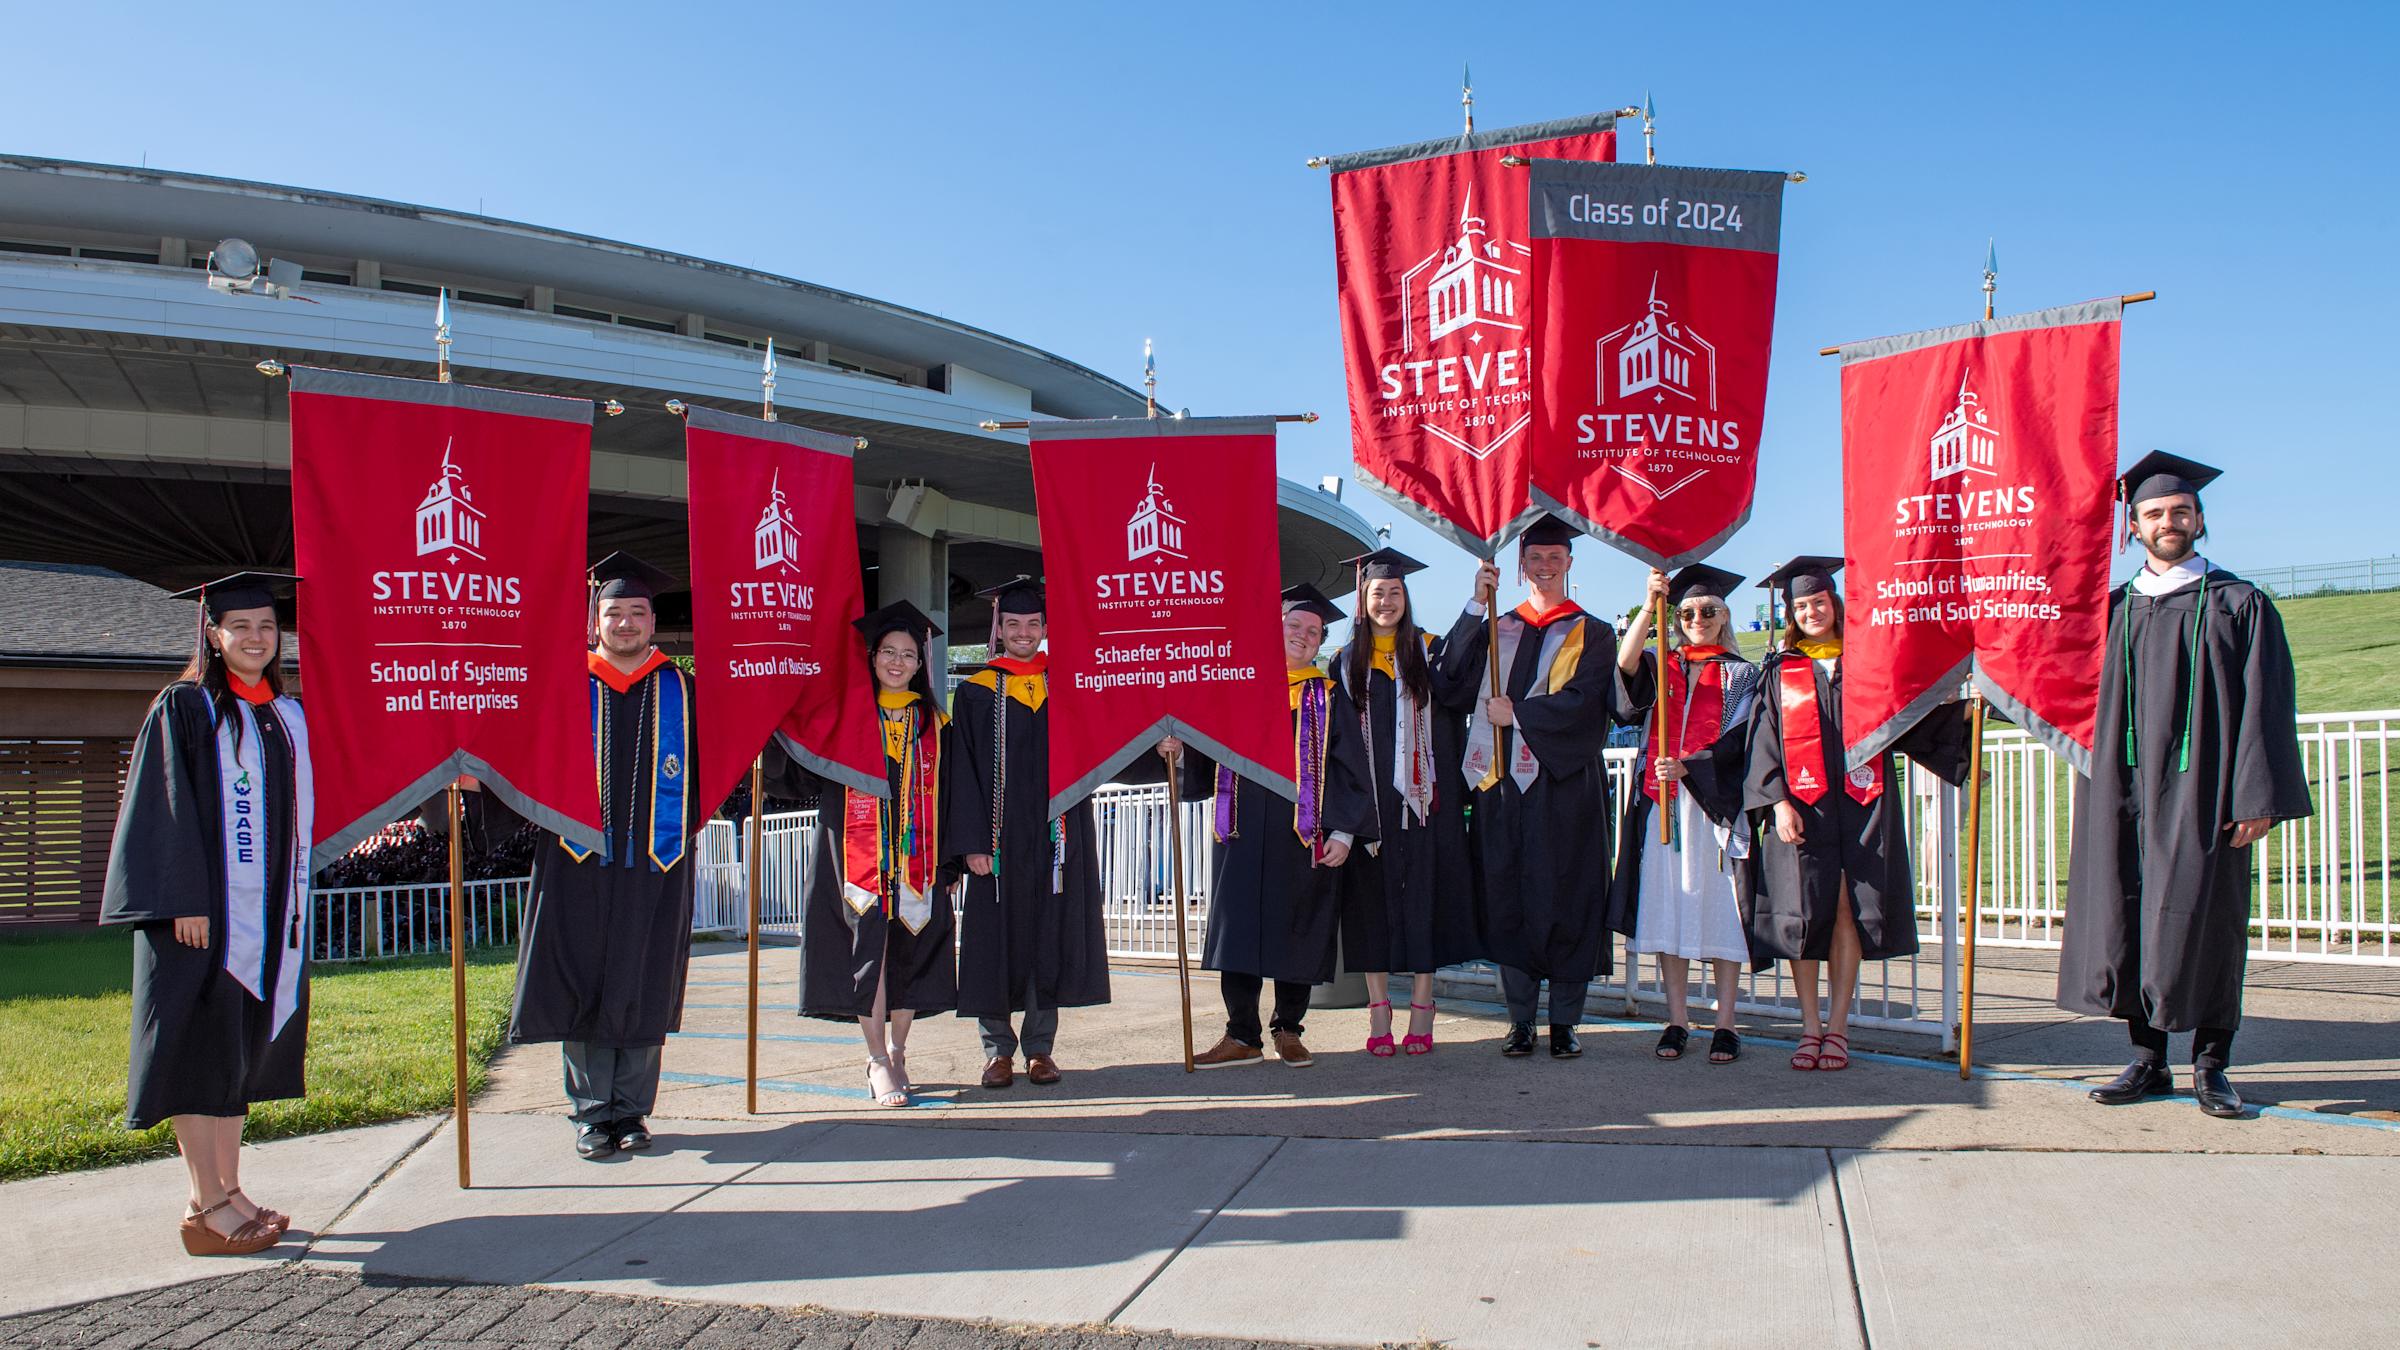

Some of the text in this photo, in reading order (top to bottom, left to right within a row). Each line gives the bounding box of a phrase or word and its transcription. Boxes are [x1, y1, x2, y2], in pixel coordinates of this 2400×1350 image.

[1569, 194, 1743, 232] Class of 2024
[1383, 400, 1454, 417] INSTITUTE
[1459, 398, 1479, 409] OF
[1464, 414, 1496, 427] 1870
[1577, 413, 1740, 450] STEVENS
[1578, 448, 1741, 464] INSTITUTE OF TECHNOLOGY
[1648, 463, 1674, 473] 1870
[1896, 486, 2036, 524] STEVENS
[1895, 518, 2033, 539] INSTITUTE OF TECHNOLOGY
[373, 571, 521, 604] STEVENS
[730, 582, 814, 610] STEVENS
[1097, 570, 1225, 598] STEVENS
[1876, 575, 1934, 600] School
[1938, 575, 1956, 594] of
[373, 605, 521, 618] INSTITUTE OF TECHNOLOGY
[731, 611, 774, 620] INSTITUTE
[776, 610, 787, 619] OF
[1098, 600, 1145, 610] INSTITUTE
[1164, 597, 1225, 606] TECHNOLOGY
[1151, 610, 1172, 618] 1870
[1871, 606, 1904, 627] Arts
[1907, 602, 1942, 622] and
[1983, 597, 2061, 620] Sciences
[442, 620, 467, 630] 1870
[1095, 640, 1232, 665] Schaefer School of
[370, 660, 528, 686] School of Systems
[729, 656, 777, 679] School
[778, 656, 788, 675] of
[1075, 664, 1256, 693] Engineering and Science
[385, 688, 519, 714] and Enterprises
[236, 800, 253, 862] SASE
